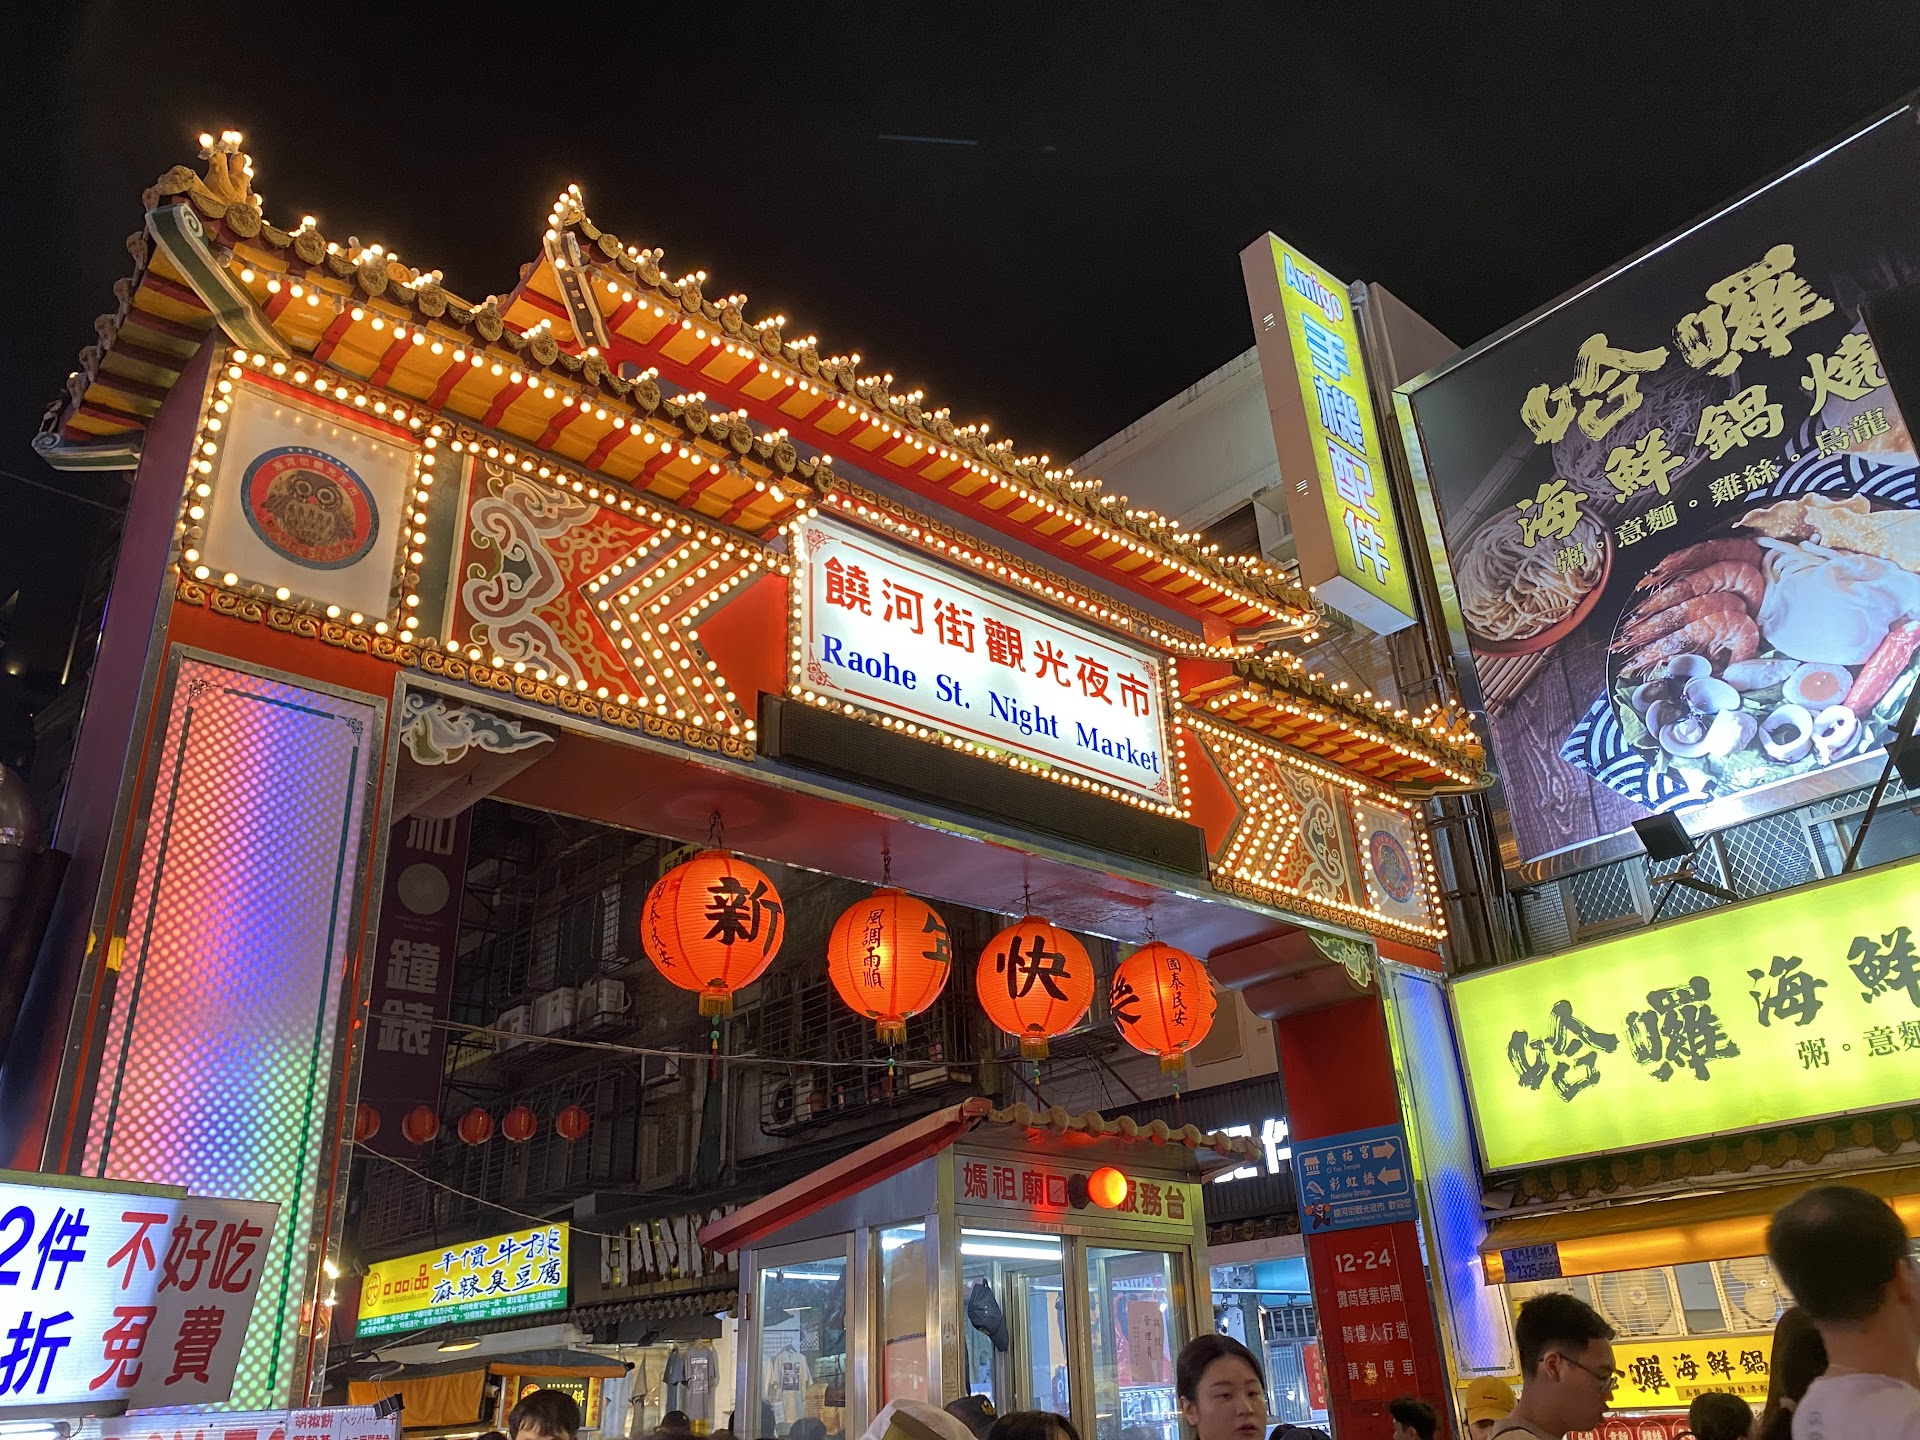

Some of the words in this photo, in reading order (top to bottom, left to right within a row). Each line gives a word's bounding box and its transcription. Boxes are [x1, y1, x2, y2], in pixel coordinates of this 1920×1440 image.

[1283, 253, 1344, 323] Amigo
[1520, 243, 1835, 445] 哈囉
[1302, 313, 1391, 584] 手機配件
[1517, 333, 1886, 548] 海鮮鍋燒
[824, 557, 1151, 717] 饒河街觀光夜市
[821, 634, 917, 691] Raohe
[935, 673, 971, 709] St.
[989, 691, 1060, 739] Night
[1076, 721, 1160, 774] Market
[702, 877, 783, 958] 新
[861, 908, 885, 990] 風調雨順
[376, 939, 441, 1056] 鐘錶
[996, 935, 1071, 1003] 快
[1166, 958, 1188, 1027] 國泰民安
[963, 1162, 1070, 1208] 媽祖廟口
[1329, 1172, 1375, 1191] 彩虹橋
[1331, 1192, 1353, 1200] Rainbow
[1354, 1189, 1372, 1197] Bridge
[1343, 1163, 1361, 1171] Temple
[0, 1206, 89, 1290] 2件
[106, 1211, 263, 1293] 不好吃
[430, 1258, 561, 1304] 麻辣臭豆腐
[434, 1228, 561, 1274] 平價牛排
[1337, 1284, 1403, 1308] 攤商營業時間
[88, 1305, 226, 1391] 免費
[1342, 1321, 1409, 1344] 騎樓人行道
[1347, 1359, 1414, 1380] 請勿停車
[1611, 1350, 1769, 1395] 囉海鮮鍋
[294, 1413, 334, 1429] 胡椒餅
